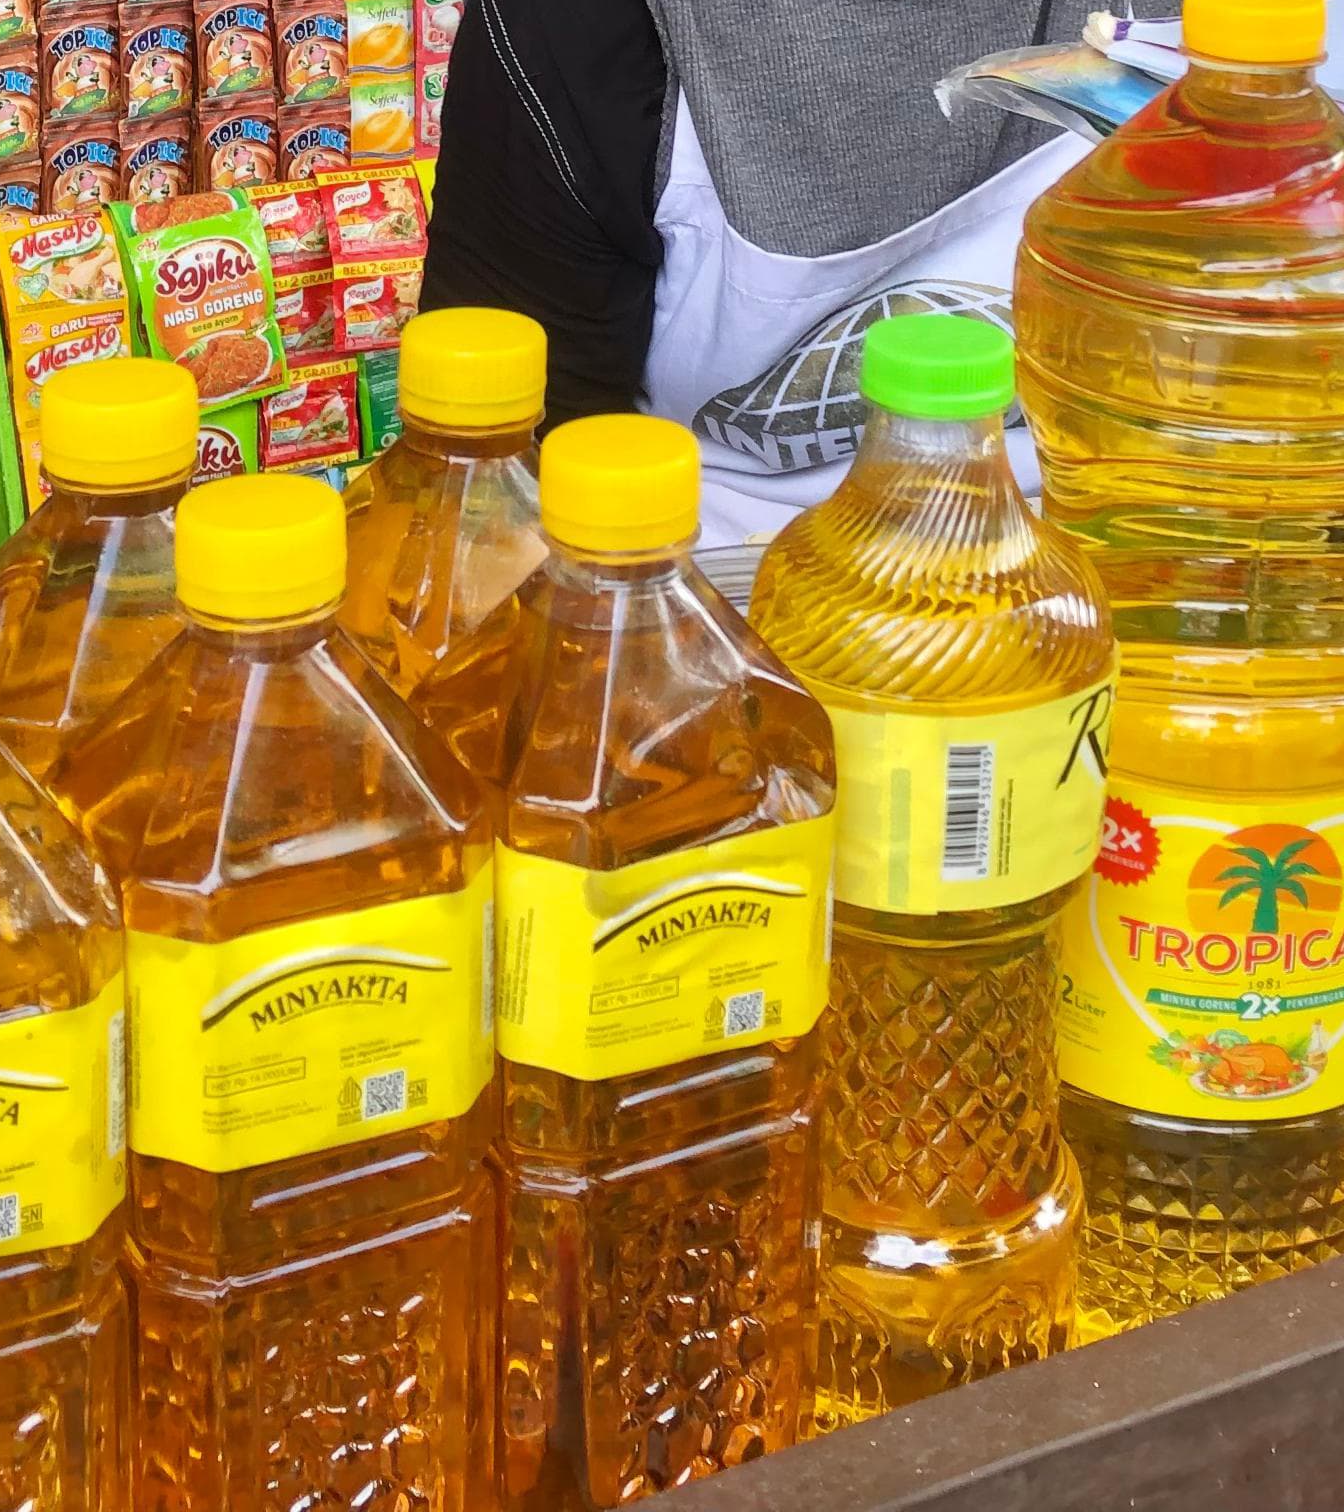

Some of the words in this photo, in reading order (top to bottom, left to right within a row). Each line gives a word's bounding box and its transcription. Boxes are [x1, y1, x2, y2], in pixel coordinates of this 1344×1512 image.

[326, 171, 351, 182] BELI
[353, 170, 361, 180] 2
[362, 168, 401, 180] GRATIS
[402, 167, 410, 177] 1
[11, 217, 97, 262] Masako
[156, 249, 260, 305] Sajiku
[50, 316, 88, 337] BARU
[163, 307, 199, 329] NASI
[203, 290, 264, 318] GORENG
[636, 899, 773, 954] MINYAKITA
[249, 973, 409, 1033] MINYAKITA
[1247, 978, 1282, 991] 1981
[1159, 992, 1197, 1008] MINYAK
[1198, 996, 1237, 1011] GORENG
[1239, 992, 1282, 1021] 2x
